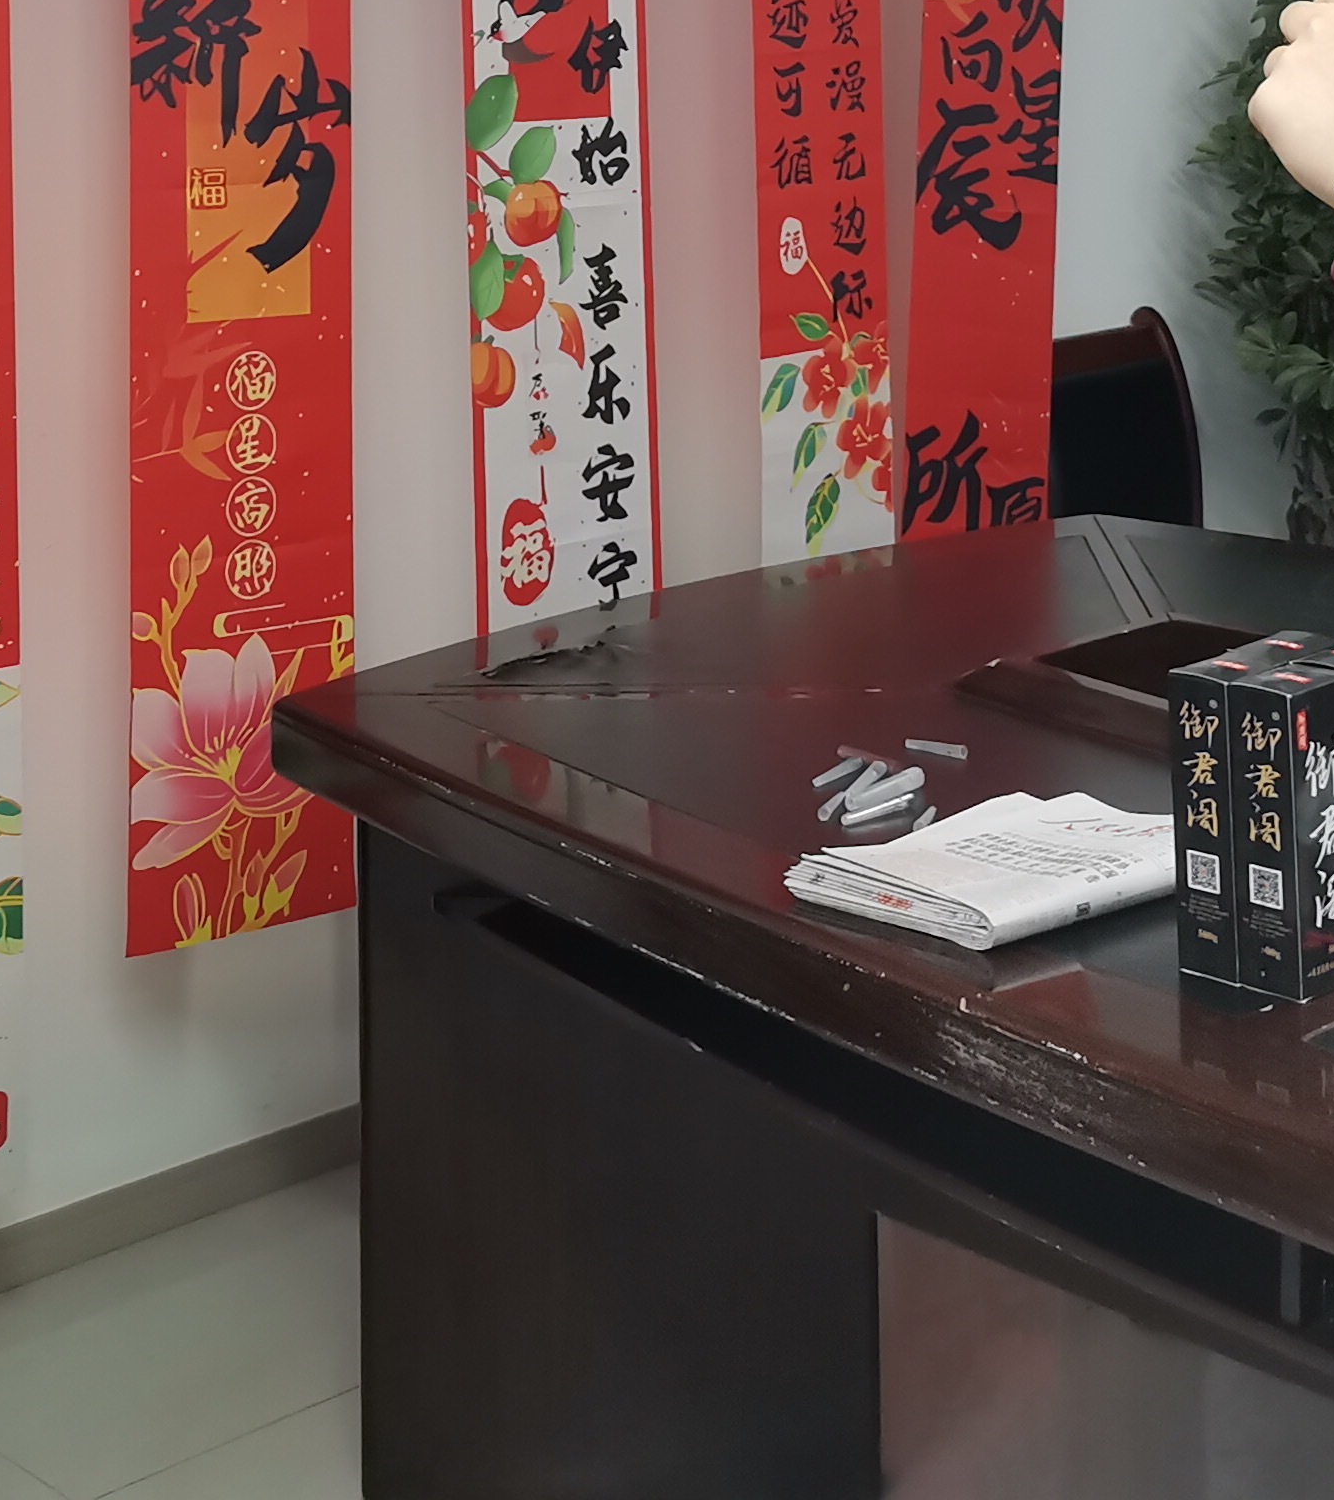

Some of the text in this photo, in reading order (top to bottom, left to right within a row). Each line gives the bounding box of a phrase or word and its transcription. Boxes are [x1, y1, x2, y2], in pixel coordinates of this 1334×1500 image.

[567, 16, 630, 187] 伊始
[191, 167, 226, 207] 福
[780, 230, 803, 262] 福
[227, 352, 273, 594] 福星高照
[579, 244, 638, 611] 喜乐安宁
[501, 518, 551, 588] 福
